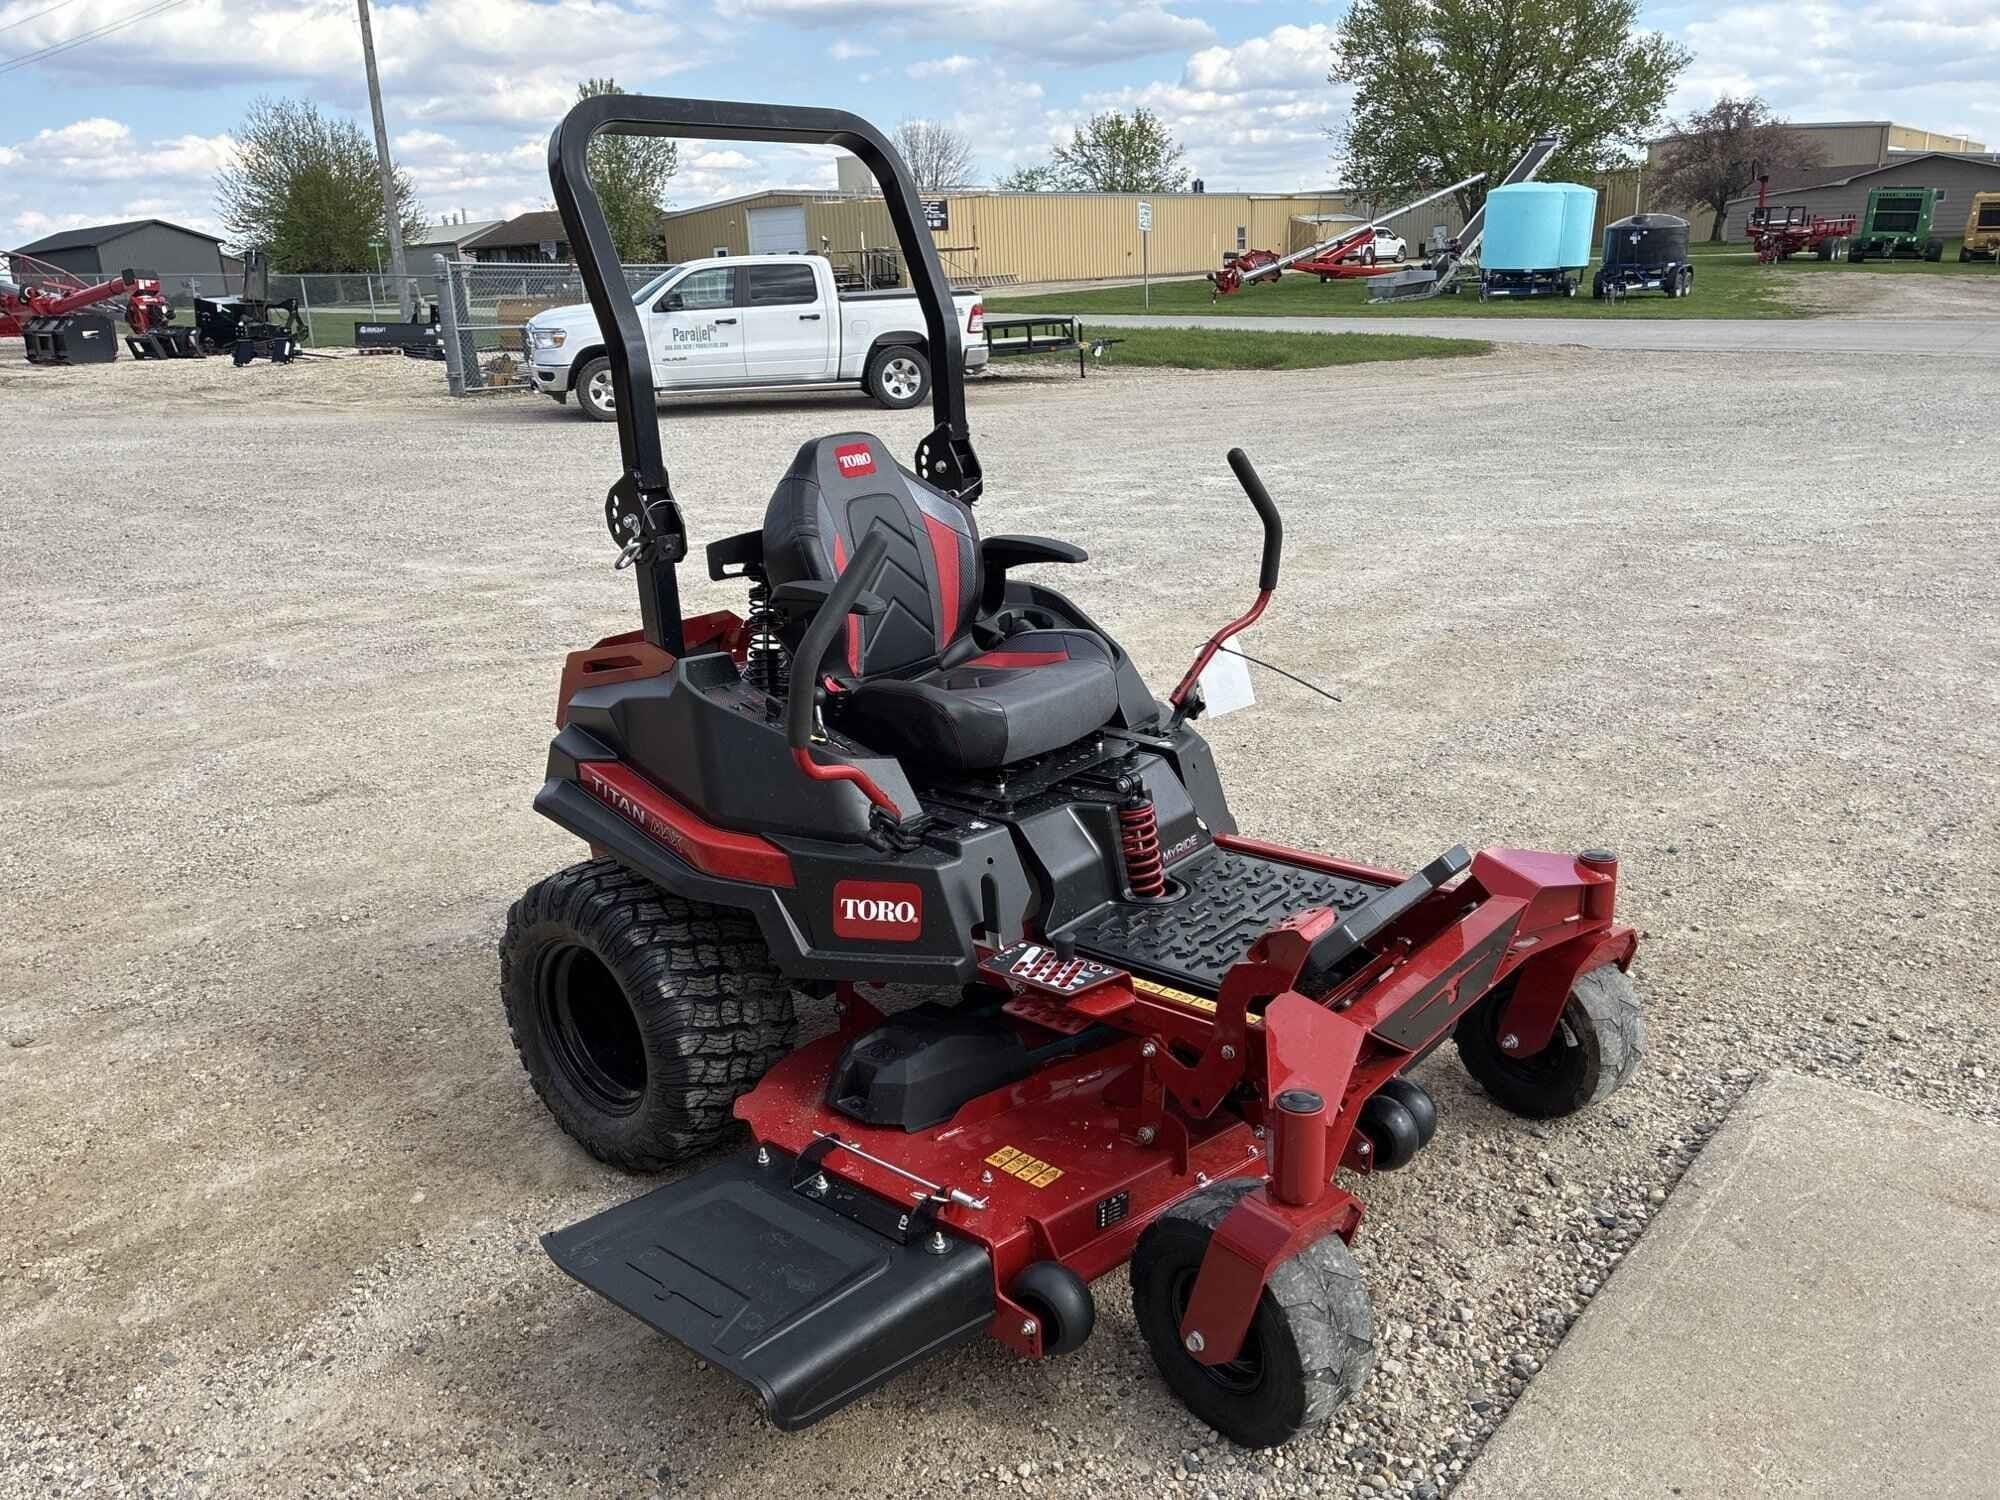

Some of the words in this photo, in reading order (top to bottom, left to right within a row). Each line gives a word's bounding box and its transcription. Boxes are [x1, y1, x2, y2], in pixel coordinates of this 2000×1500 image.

[840, 452, 872, 468] TORO
[591, 775, 646, 825] TITAN
[840, 898, 916, 923] TORO
